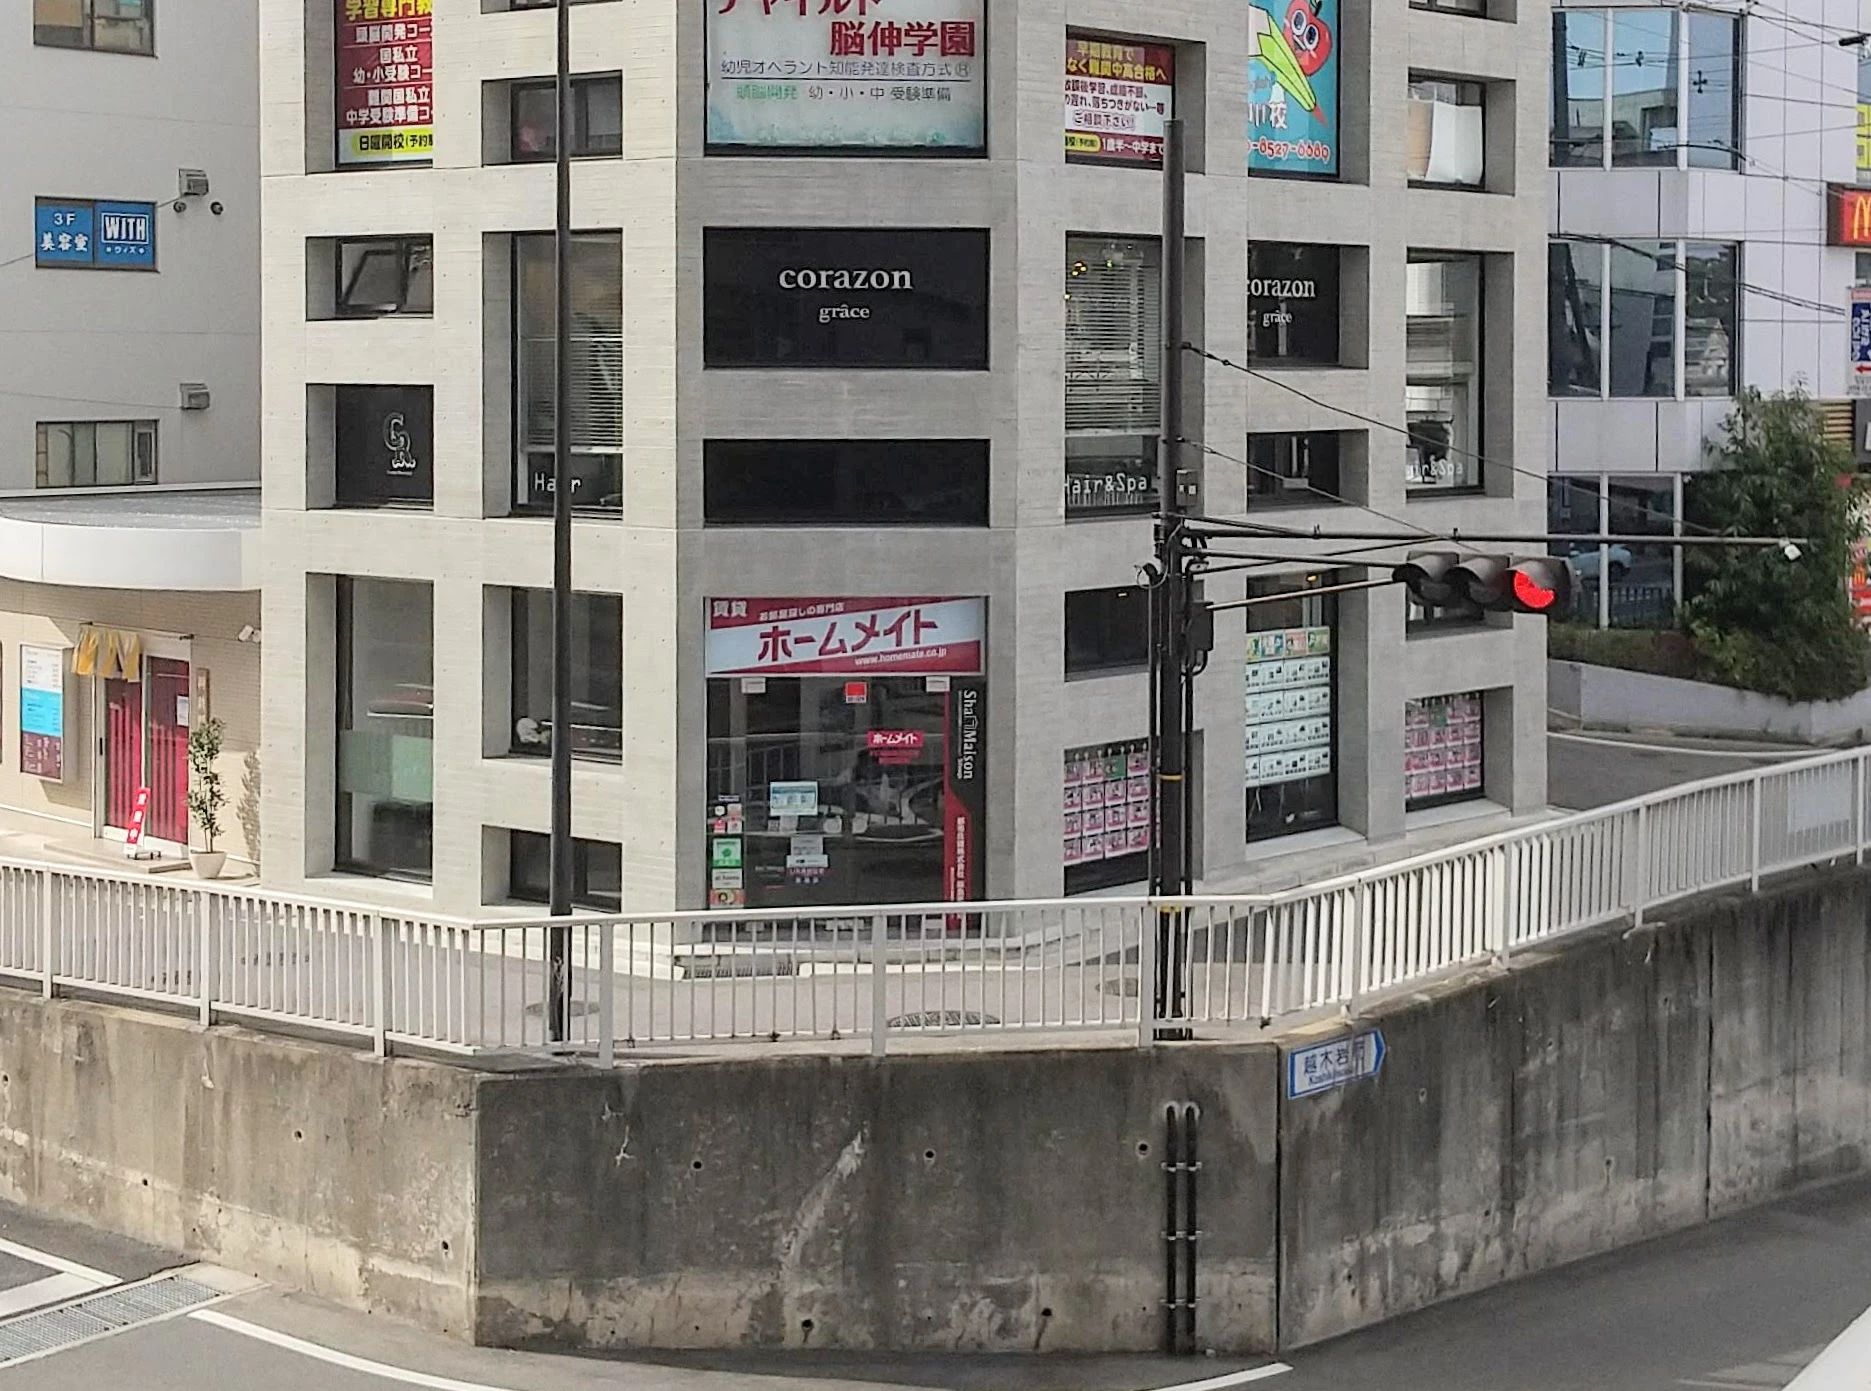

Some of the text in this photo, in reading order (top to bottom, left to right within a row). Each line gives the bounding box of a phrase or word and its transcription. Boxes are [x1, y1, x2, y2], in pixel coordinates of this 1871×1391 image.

[355, 22, 433, 44] 頭脳開発コー
[830, 20, 976, 57] 脳伸学園
[346, 105, 433, 126] 中学受験準備コ
[53, 212, 76, 226] 3F
[104, 216, 146, 241] WITH
[40, 231, 89, 252] 美容室
[778, 268, 913, 291] corazon
[1247, 278, 1316, 298] orazon
[818, 304, 870, 323] grâce
[534, 471, 582, 494] Har
[758, 608, 939, 662] ホームメイト
[872, 732, 918, 745] ホームメイト
